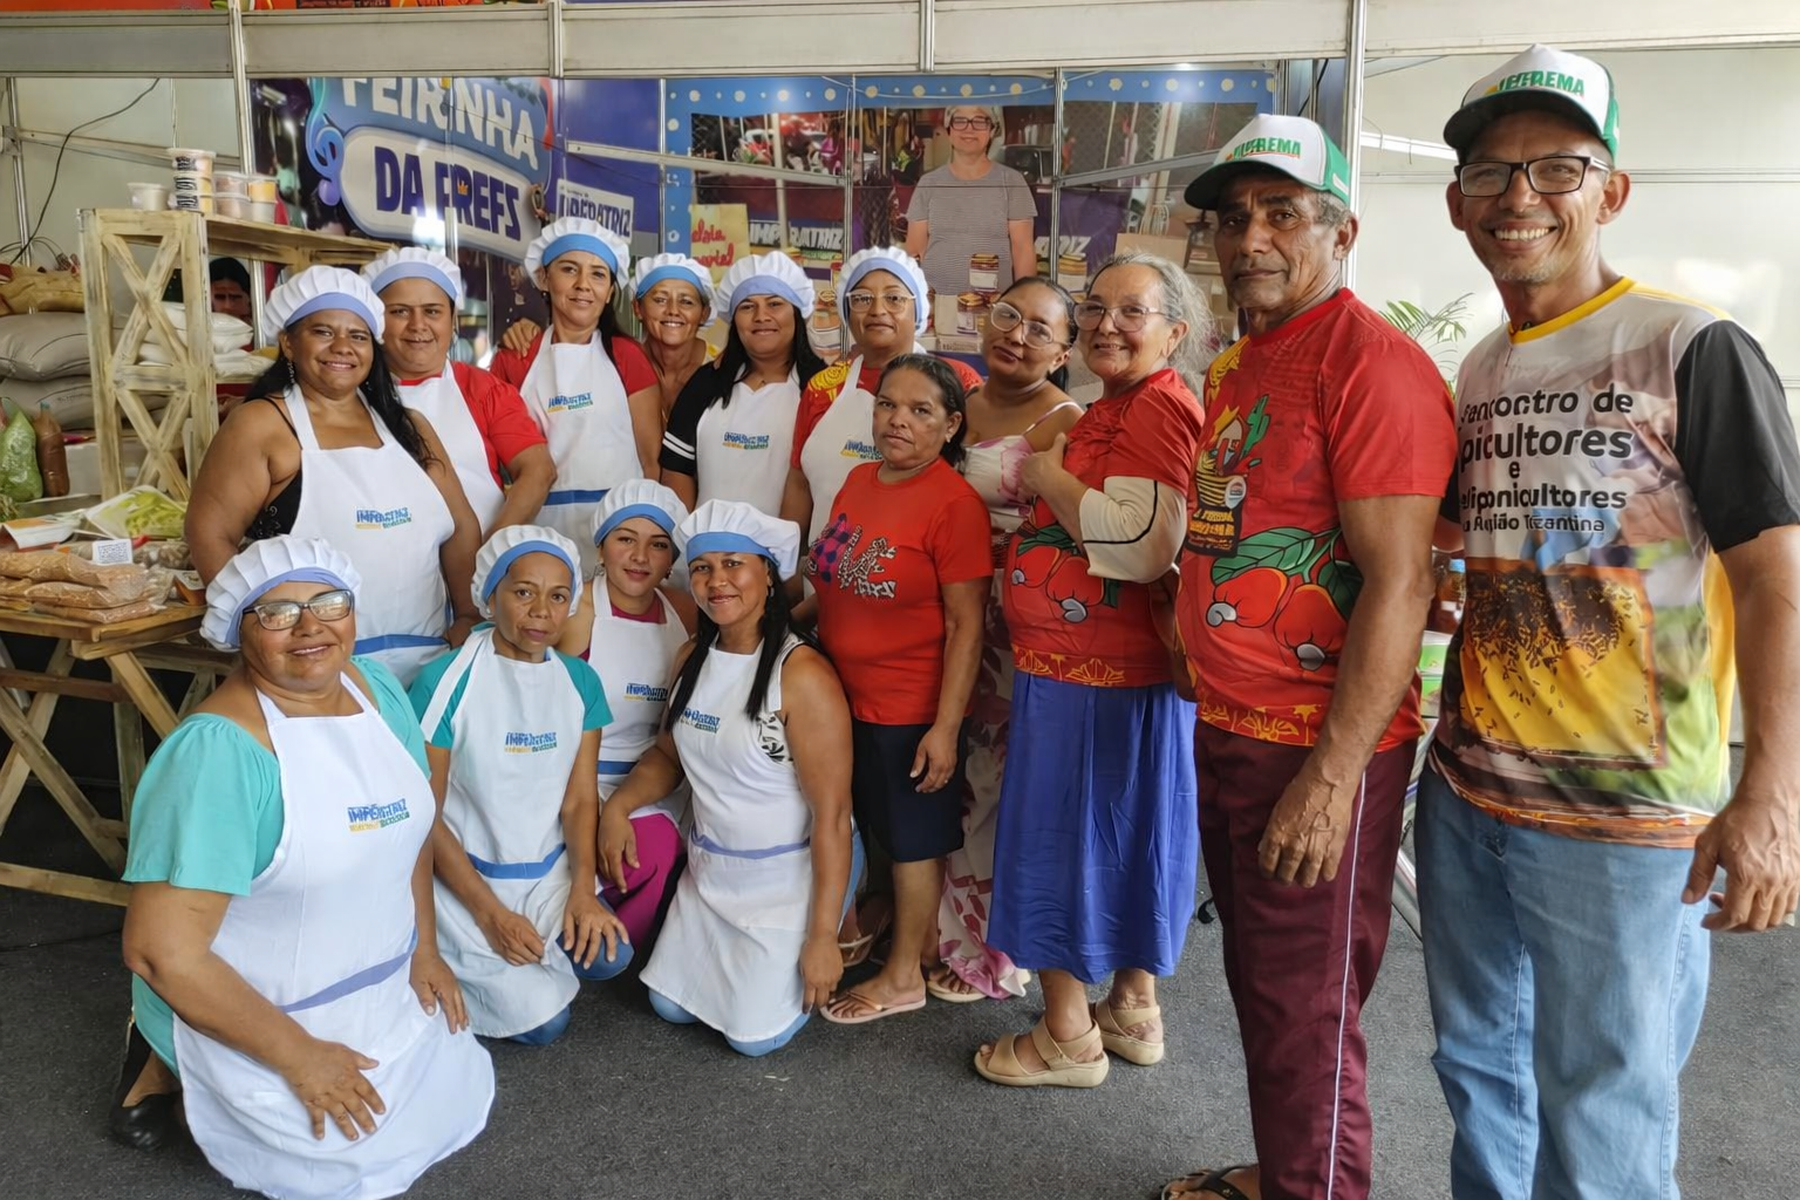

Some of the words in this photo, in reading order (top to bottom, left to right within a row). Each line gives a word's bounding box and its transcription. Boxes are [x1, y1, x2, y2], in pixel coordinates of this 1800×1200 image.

[374, 145, 427, 217] DA
[1593, 382, 1634, 413] de
[1459, 422, 1633, 473] picultores
[1508, 460, 1521, 479] e
